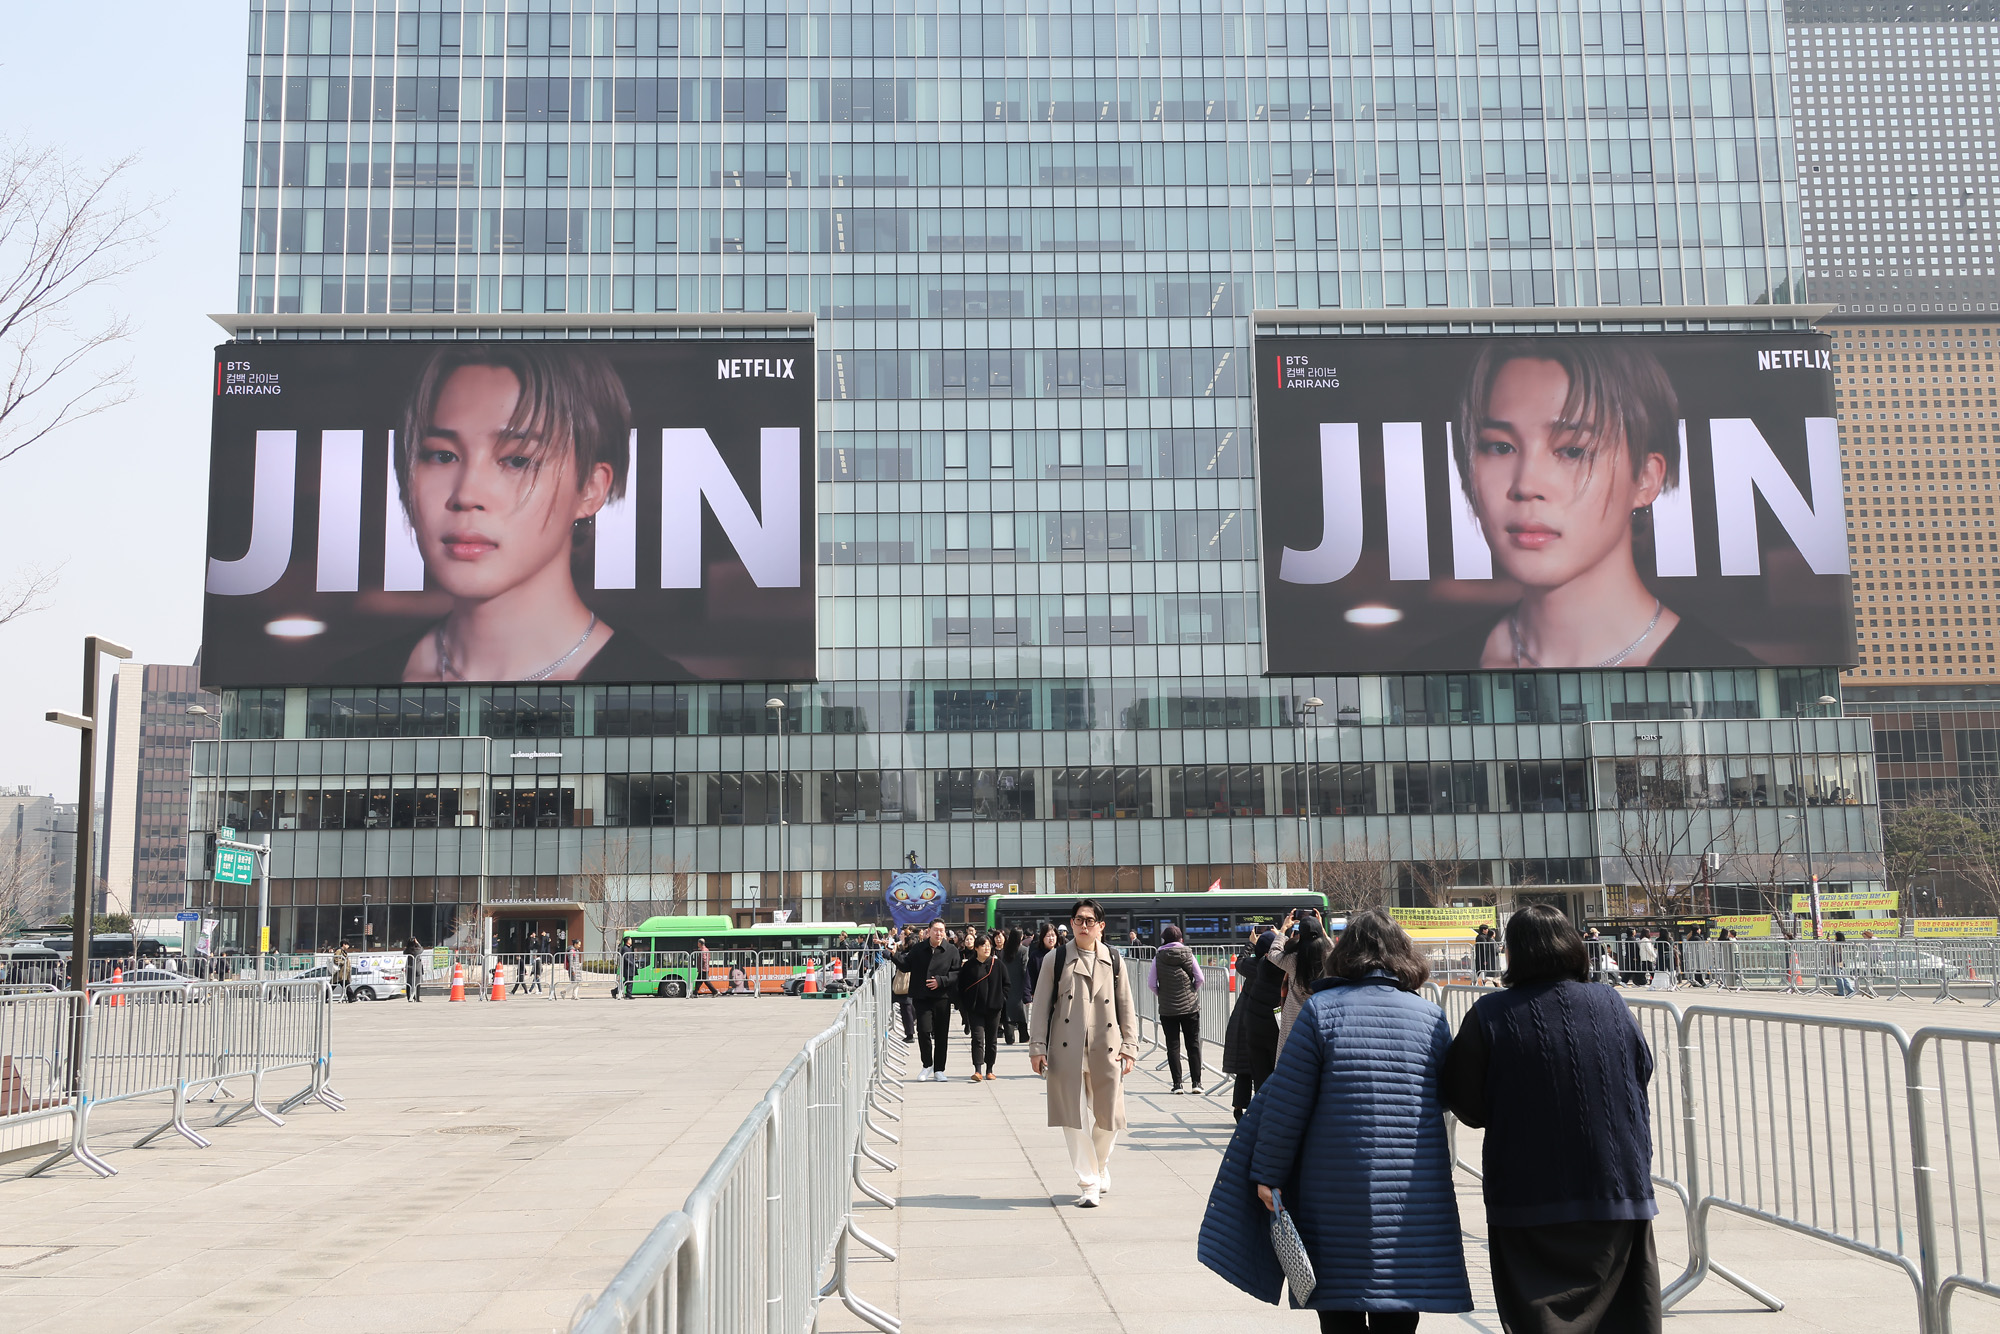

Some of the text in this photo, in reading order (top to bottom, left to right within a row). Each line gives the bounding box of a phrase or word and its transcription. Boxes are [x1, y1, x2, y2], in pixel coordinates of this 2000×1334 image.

[1286, 356, 1309, 365] BTS
[1758, 350, 1832, 371] NETFLIX
[227, 361, 251, 371] BTS
[718, 358, 795, 380] NETFLIX
[1286, 367, 1337, 378] 컴백 라이브
[226, 373, 279, 384] 컴백 라이브
[1287, 379, 1340, 388] ARIRANG
[225, 385, 282, 395] ARIRANG
[517, 750, 556, 759] doughroom
[1839, 920, 1872, 928] Palestinian
[1873, 919, 1896, 928] People!
[802, 957, 821, 965] 120
